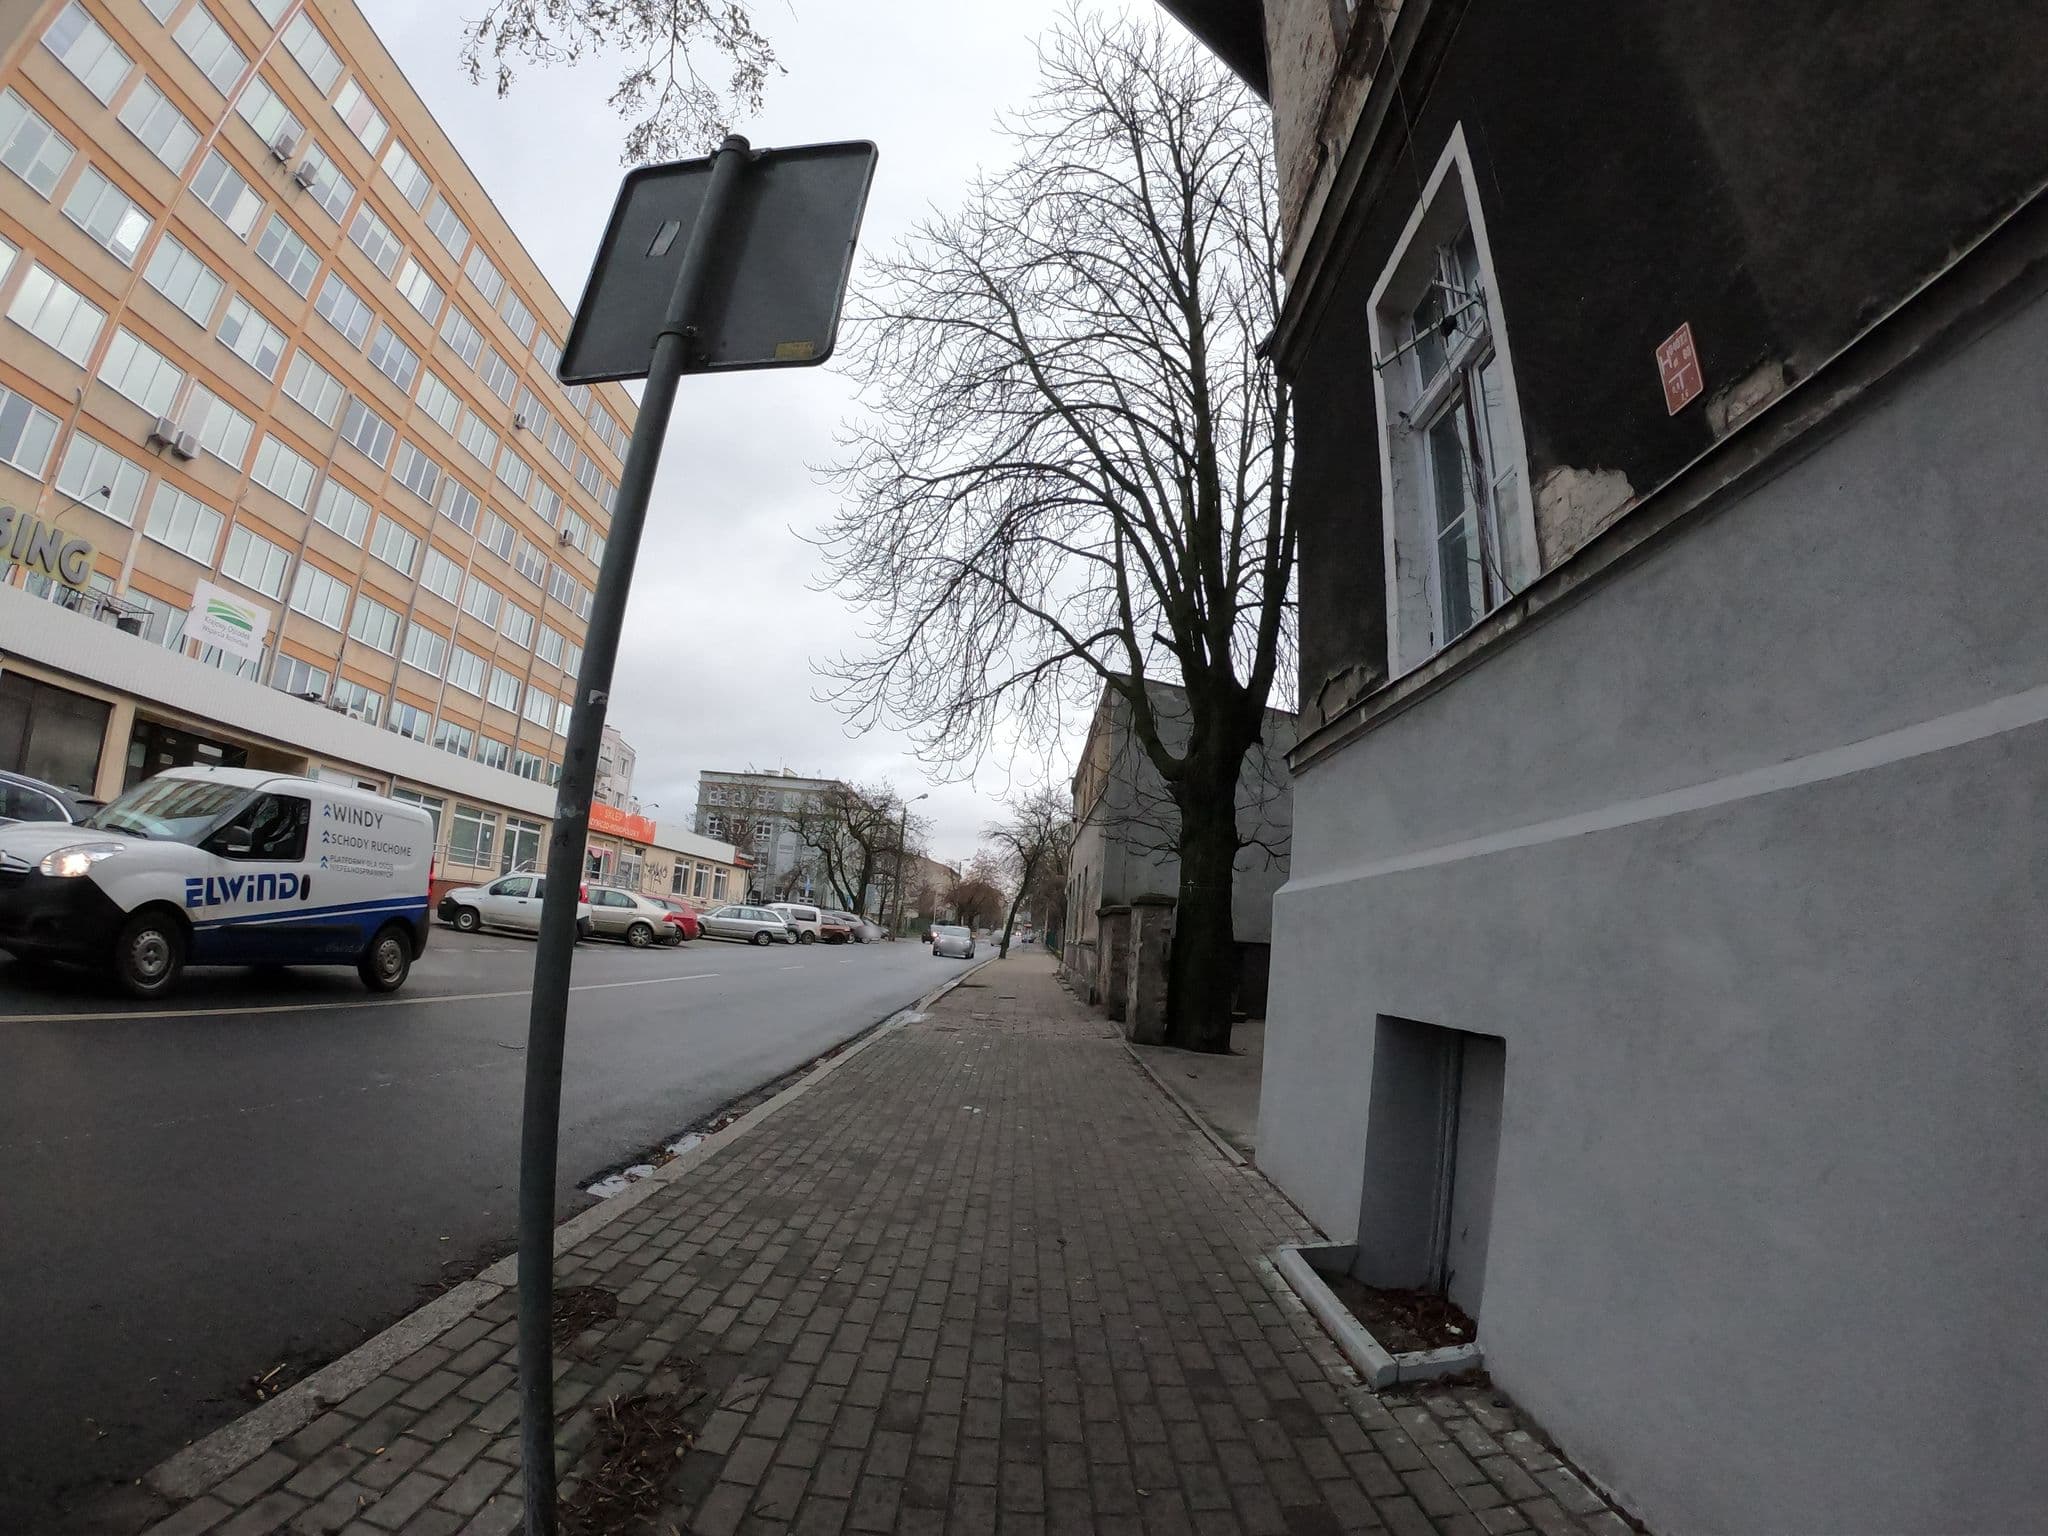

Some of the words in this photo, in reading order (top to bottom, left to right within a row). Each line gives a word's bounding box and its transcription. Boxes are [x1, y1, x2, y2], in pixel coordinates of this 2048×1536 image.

[333, 803, 383, 829] WINDY
[331, 833, 369, 850] SCHODY
[371, 840, 412, 857] RUCHOME
